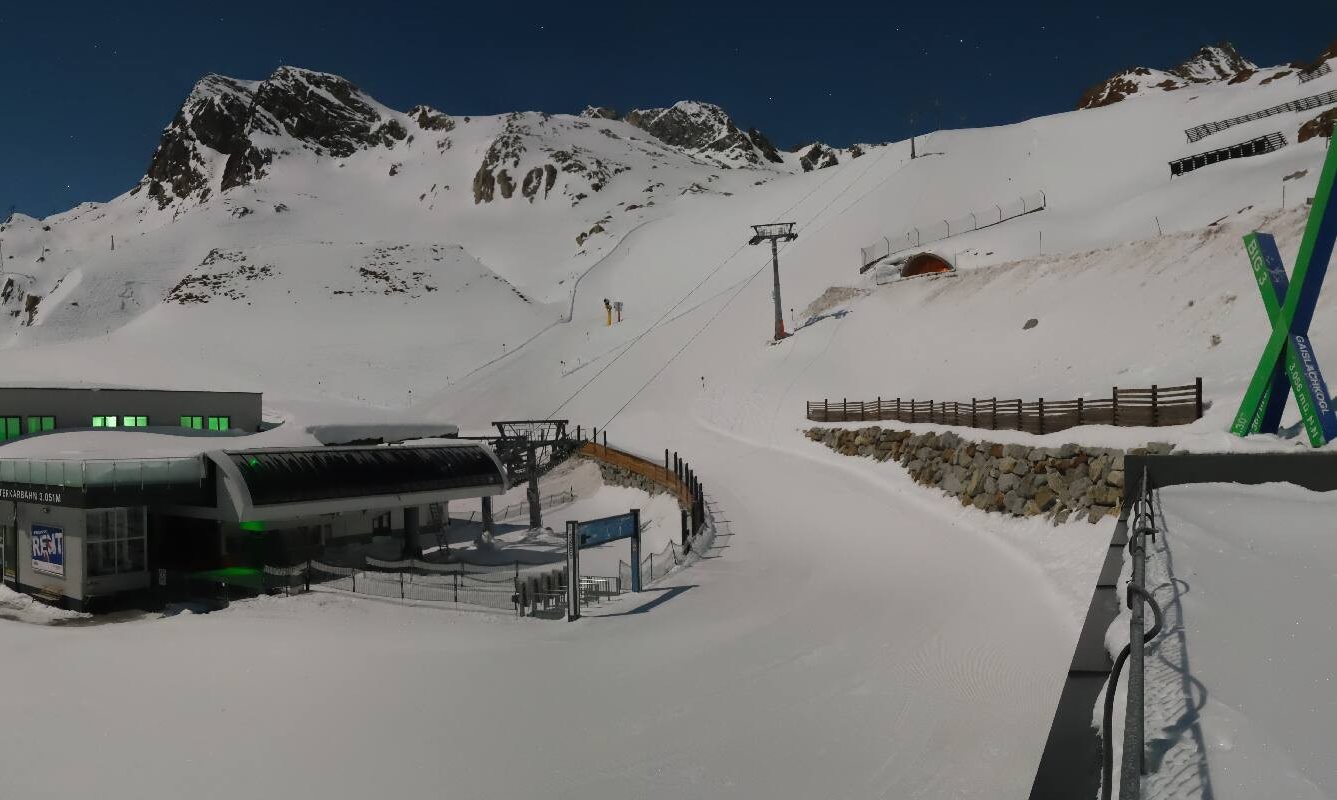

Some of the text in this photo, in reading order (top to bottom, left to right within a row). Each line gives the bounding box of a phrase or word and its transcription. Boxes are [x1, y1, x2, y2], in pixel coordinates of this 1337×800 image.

[1248, 239, 1268, 286] BIG 3
[1295, 335, 1330, 416] GAISLACHKOGL
[32, 533, 63, 557] RENT
